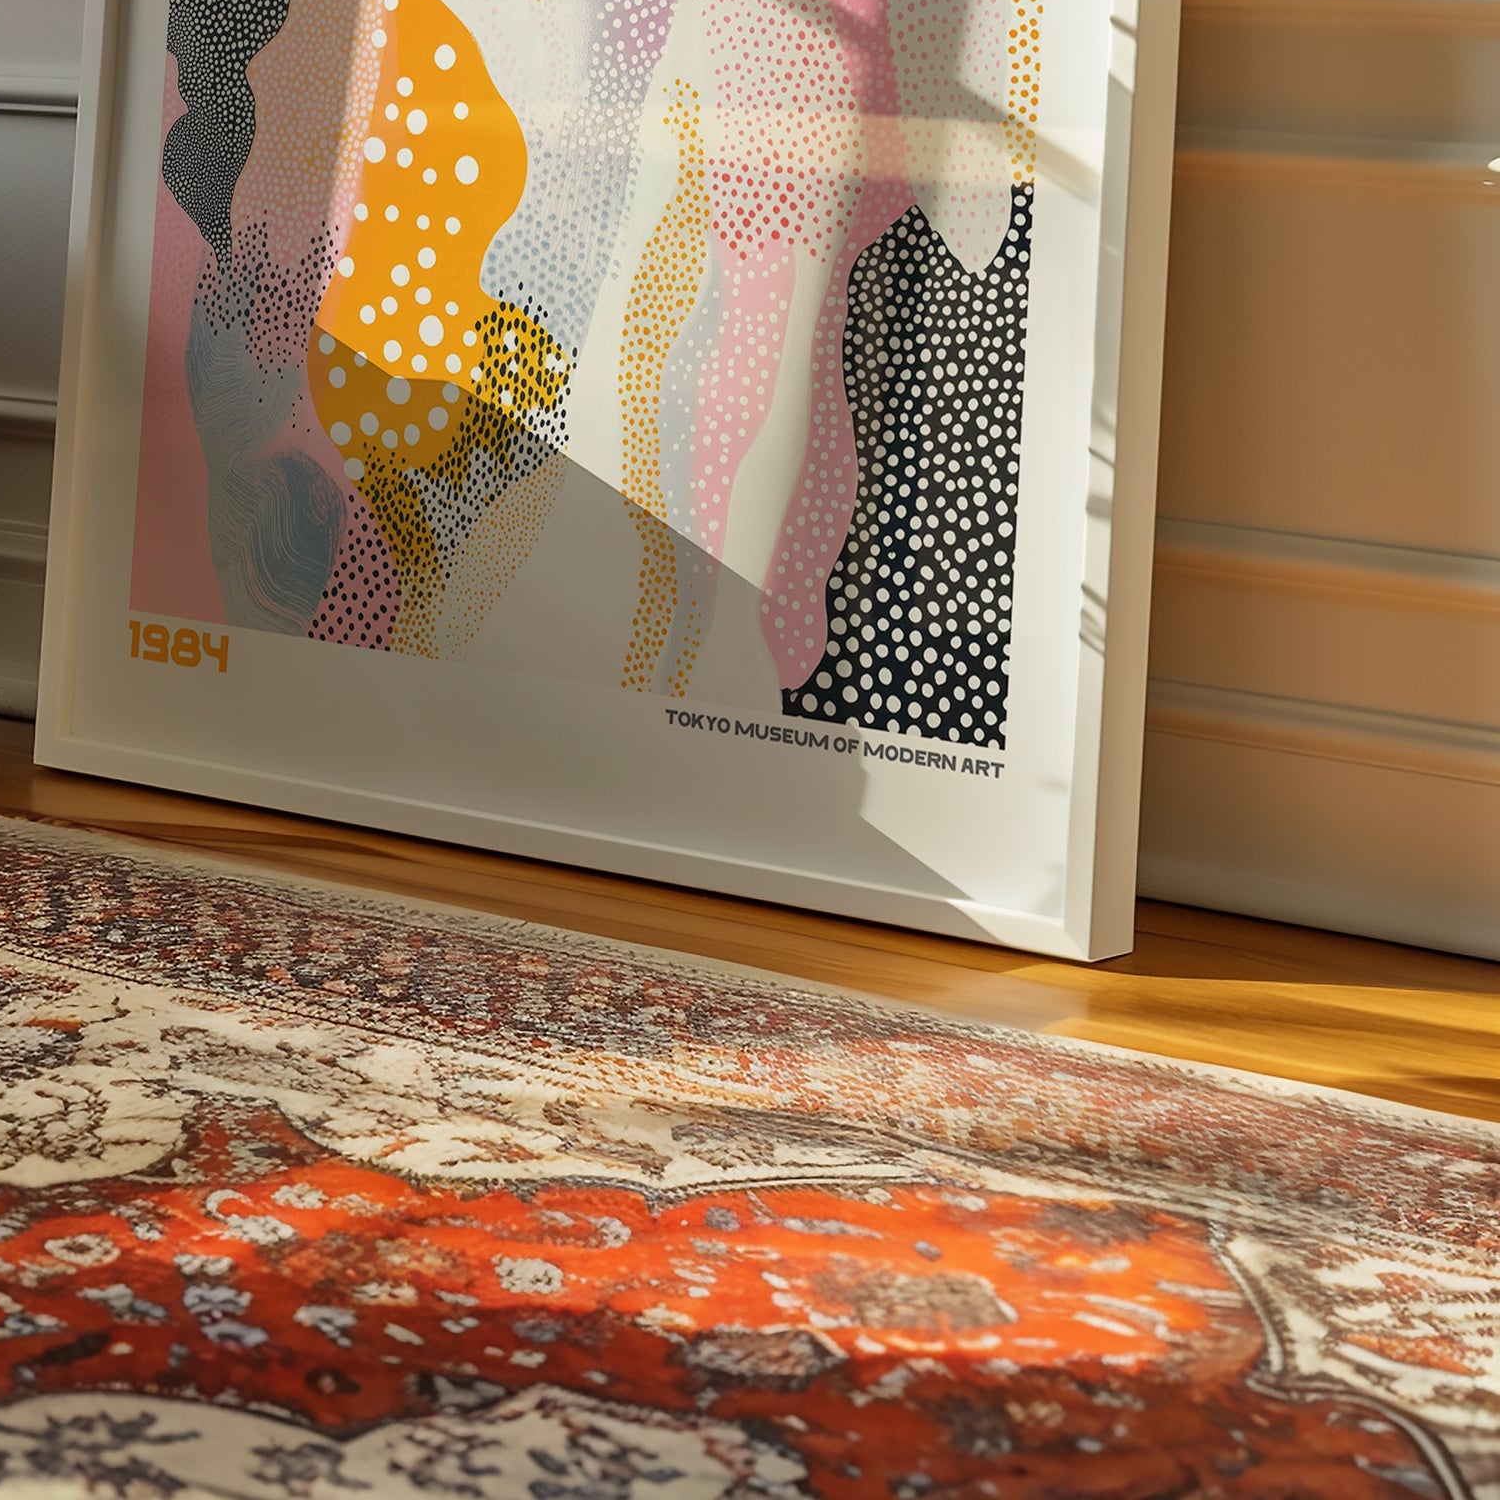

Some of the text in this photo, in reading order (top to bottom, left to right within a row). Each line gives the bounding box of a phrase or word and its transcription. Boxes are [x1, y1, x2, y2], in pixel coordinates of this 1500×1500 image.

[129, 620, 229, 673] 1984
[665, 709, 1005, 779] TOKYO MUSEUM OF MODERN ART
